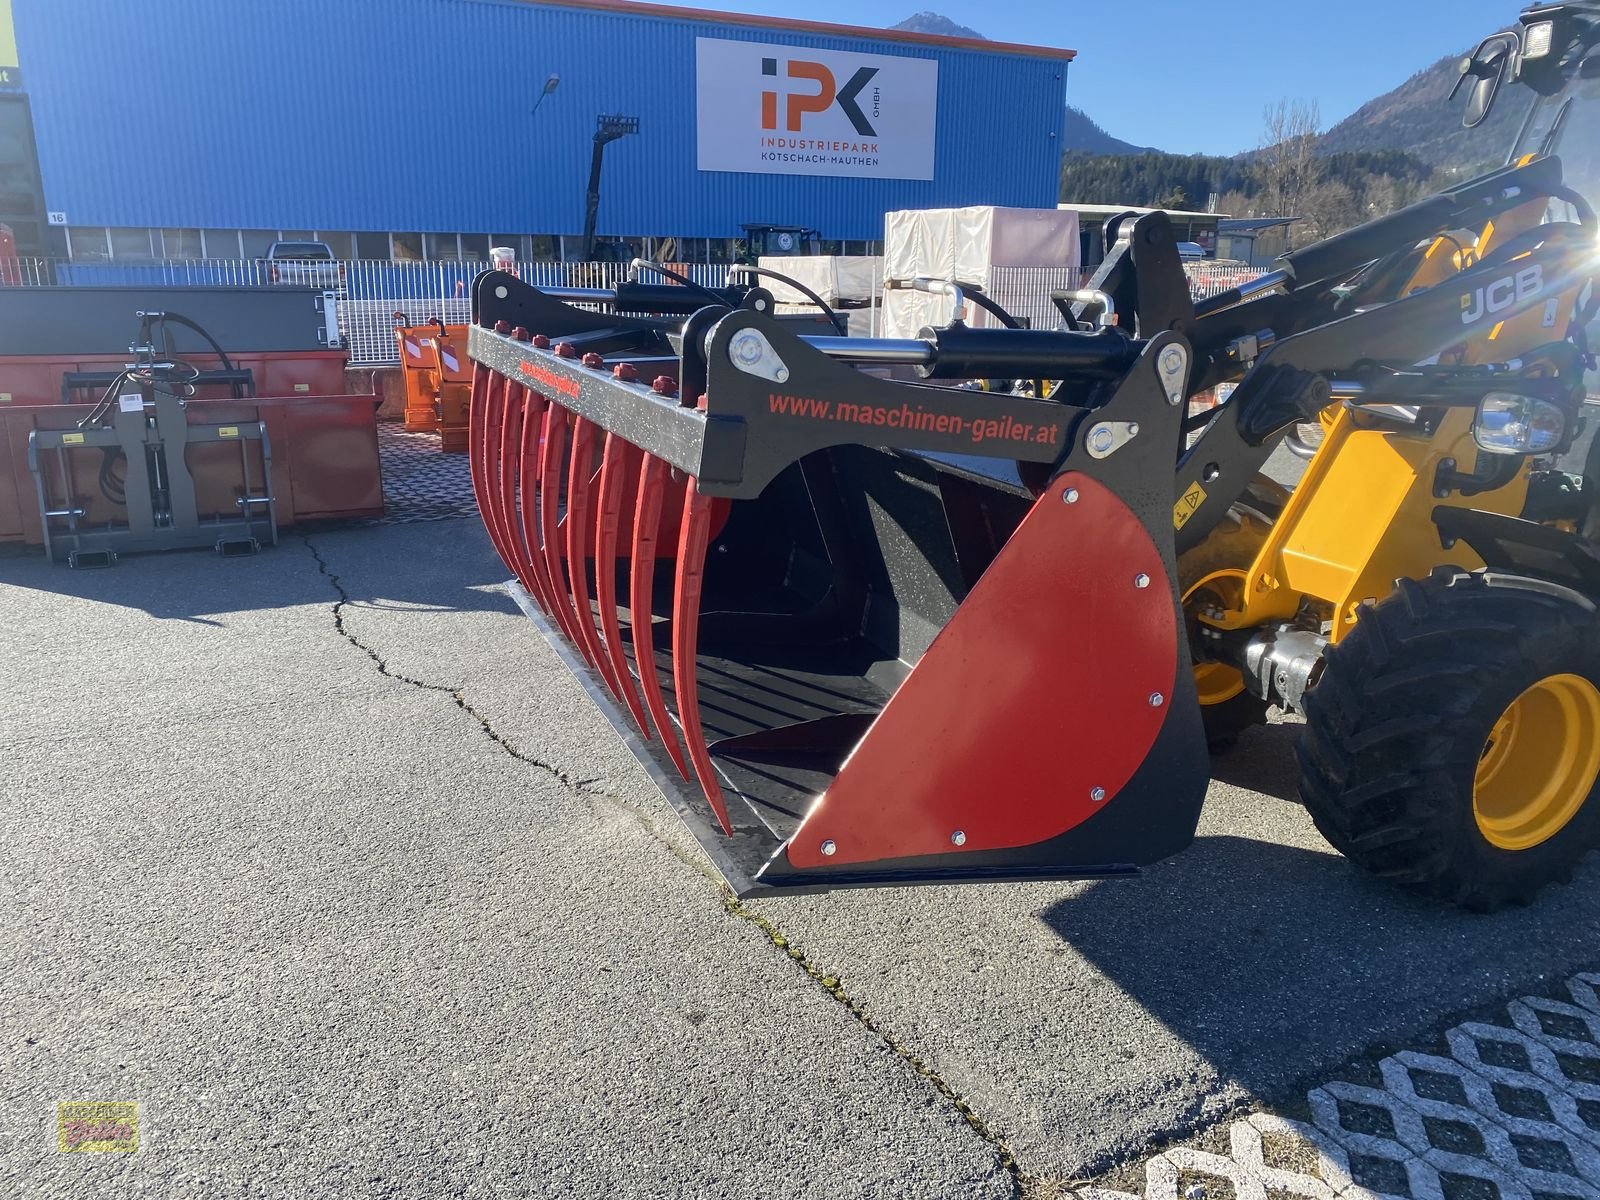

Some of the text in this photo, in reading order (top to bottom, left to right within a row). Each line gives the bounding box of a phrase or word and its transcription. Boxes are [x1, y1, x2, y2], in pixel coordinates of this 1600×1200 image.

[761, 137, 878, 153] INDUSTRIEPARK
[52, 214, 64, 222] 16
[1461, 264, 1544, 324] JCB
[769, 393, 1058, 444] www.maschinen-gailer.at
